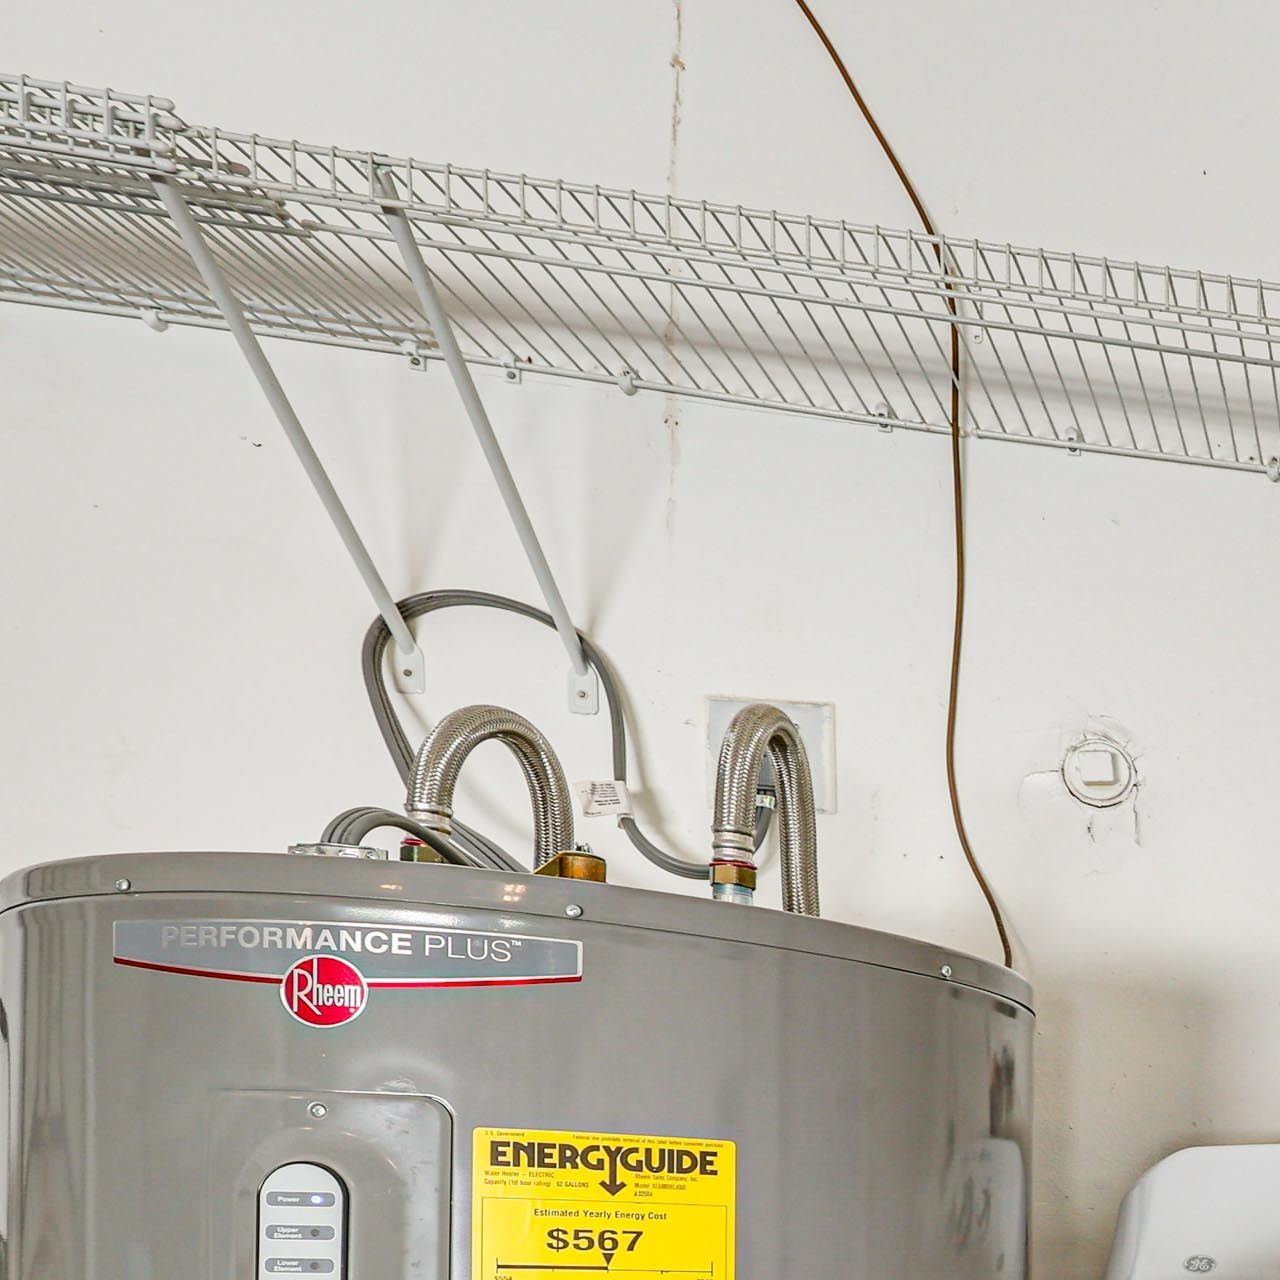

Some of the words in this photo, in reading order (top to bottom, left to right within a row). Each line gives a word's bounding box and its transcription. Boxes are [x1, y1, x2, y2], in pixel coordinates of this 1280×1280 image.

[162, 924, 413, 956] PERFORMANCE
[292, 958, 361, 1016] Rheem
[490, 1140, 718, 1175] ENERGYGUIDE
[534, 1208, 580, 1218] Estimated
[583, 1210, 612, 1220] Yearly
[614, 1210, 646, 1221] Energy
[648, 1211, 667, 1221] Cost
[546, 1227, 644, 1253] $567
